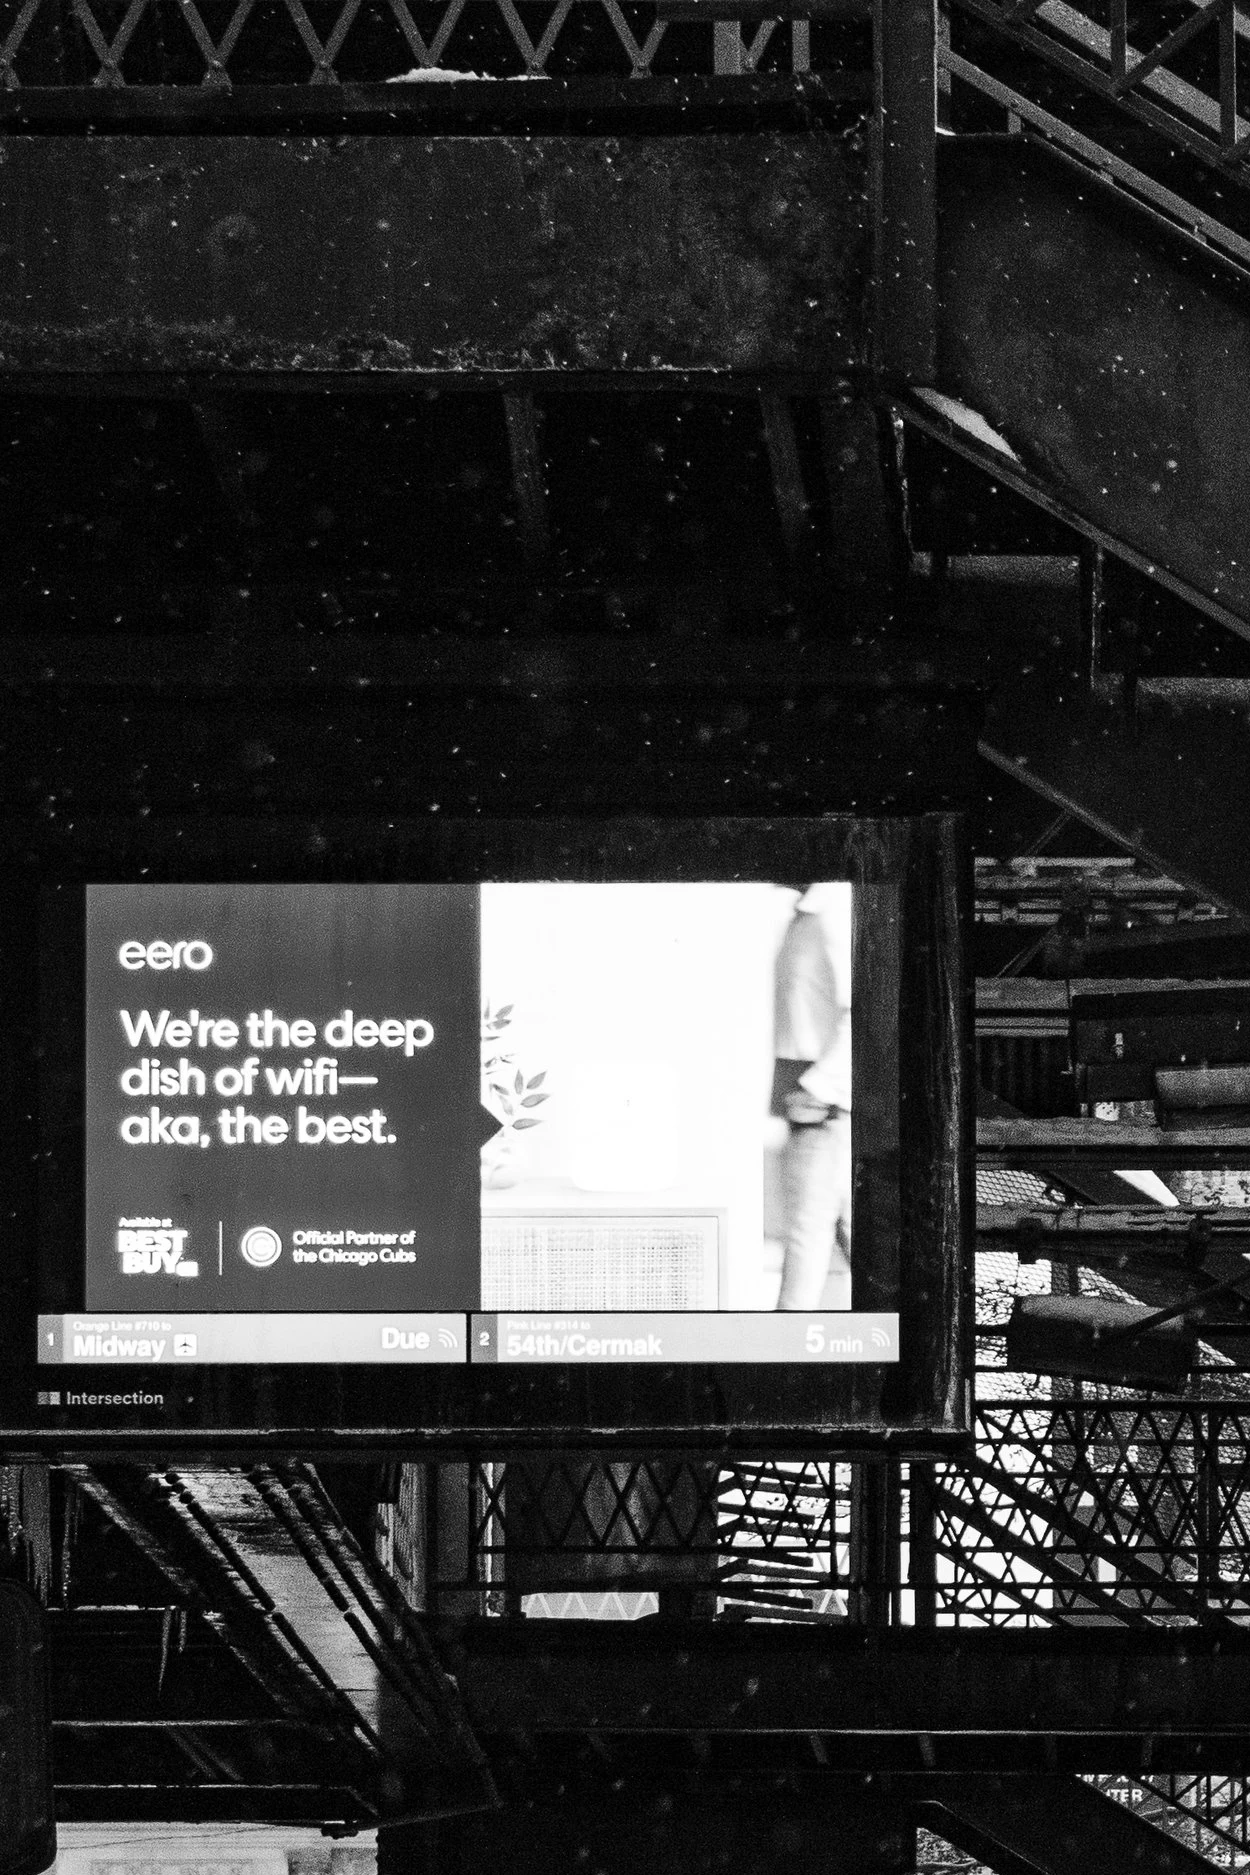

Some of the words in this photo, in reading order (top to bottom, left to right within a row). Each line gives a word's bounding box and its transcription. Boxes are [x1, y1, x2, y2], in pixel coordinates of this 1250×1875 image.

[119, 940, 213, 970] eero
[120, 1009, 240, 1048] We're
[246, 1009, 317, 1048] the
[324, 1009, 435, 1057] deep
[120, 1058, 206, 1096] dish
[214, 1058, 260, 1096] of
[120, 1106, 210, 1148] aka,
[219, 1106, 289, 1144] the
[298, 1106, 397, 1144] best.
[118, 1216, 161, 1228] Available
[162, 1217, 173, 1228] at
[118, 1229, 188, 1252] BEST
[293, 1230, 345, 1245] Official
[346, 1230, 399, 1245] Partner
[400, 1230, 417, 1245] of
[293, 1248, 318, 1263] the
[318, 1247, 378, 1266] Chicago
[379, 1247, 417, 1263] Cubs
[73, 1321, 110, 1333] Orange
[111, 1321, 133, 1331] Line
[161, 1321, 172, 1331] to
[506, 1320, 529, 1330] Pink
[530, 1320, 552, 1330] Line
[580, 1320, 591, 1330] to
[47, 1333, 54, 1346] 1
[73, 1335, 166, 1362] Midway
[381, 1328, 430, 1350] Due
[479, 1332, 489, 1346] 2
[506, 1333, 663, 1357] 54th/Cermak
[805, 1324, 825, 1353] 5
[829, 1335, 863, 1353] min
[66, 1391, 164, 1405] Intersection
